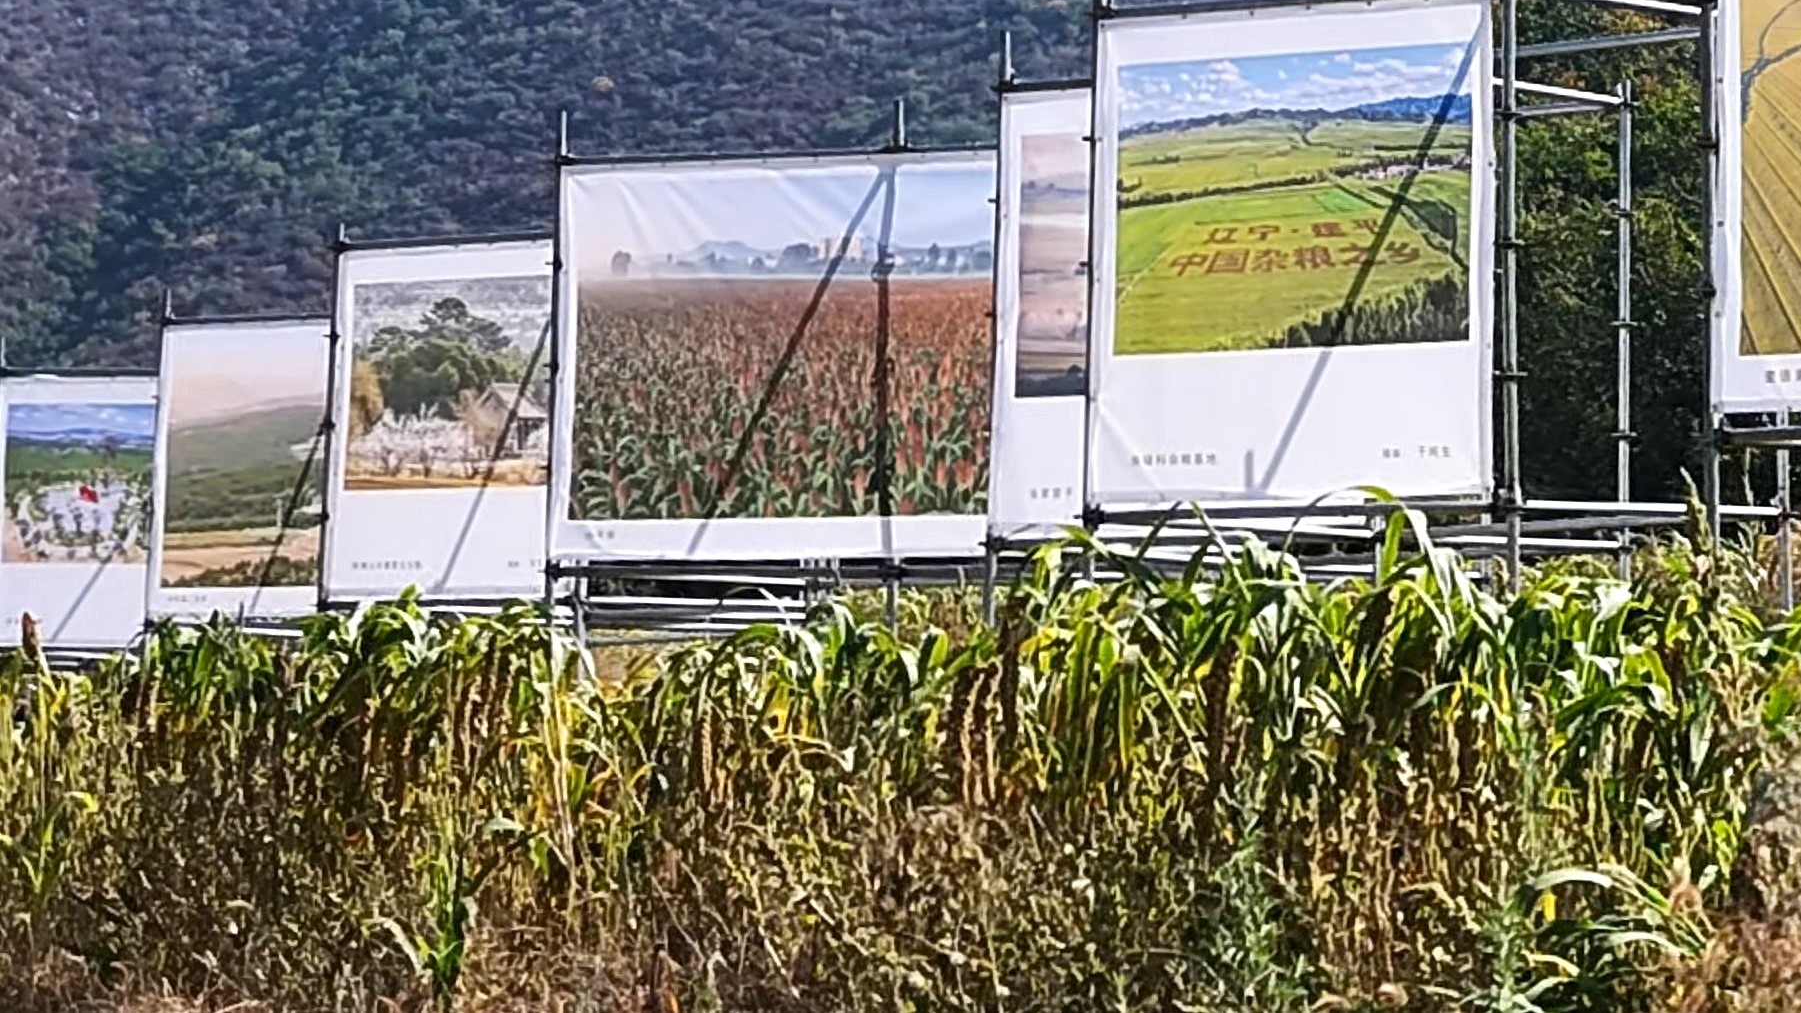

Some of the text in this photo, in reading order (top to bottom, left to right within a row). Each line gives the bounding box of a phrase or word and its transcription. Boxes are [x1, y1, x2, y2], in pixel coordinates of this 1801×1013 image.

[1168, 240, 1421, 277] 中国杂粮之乡
